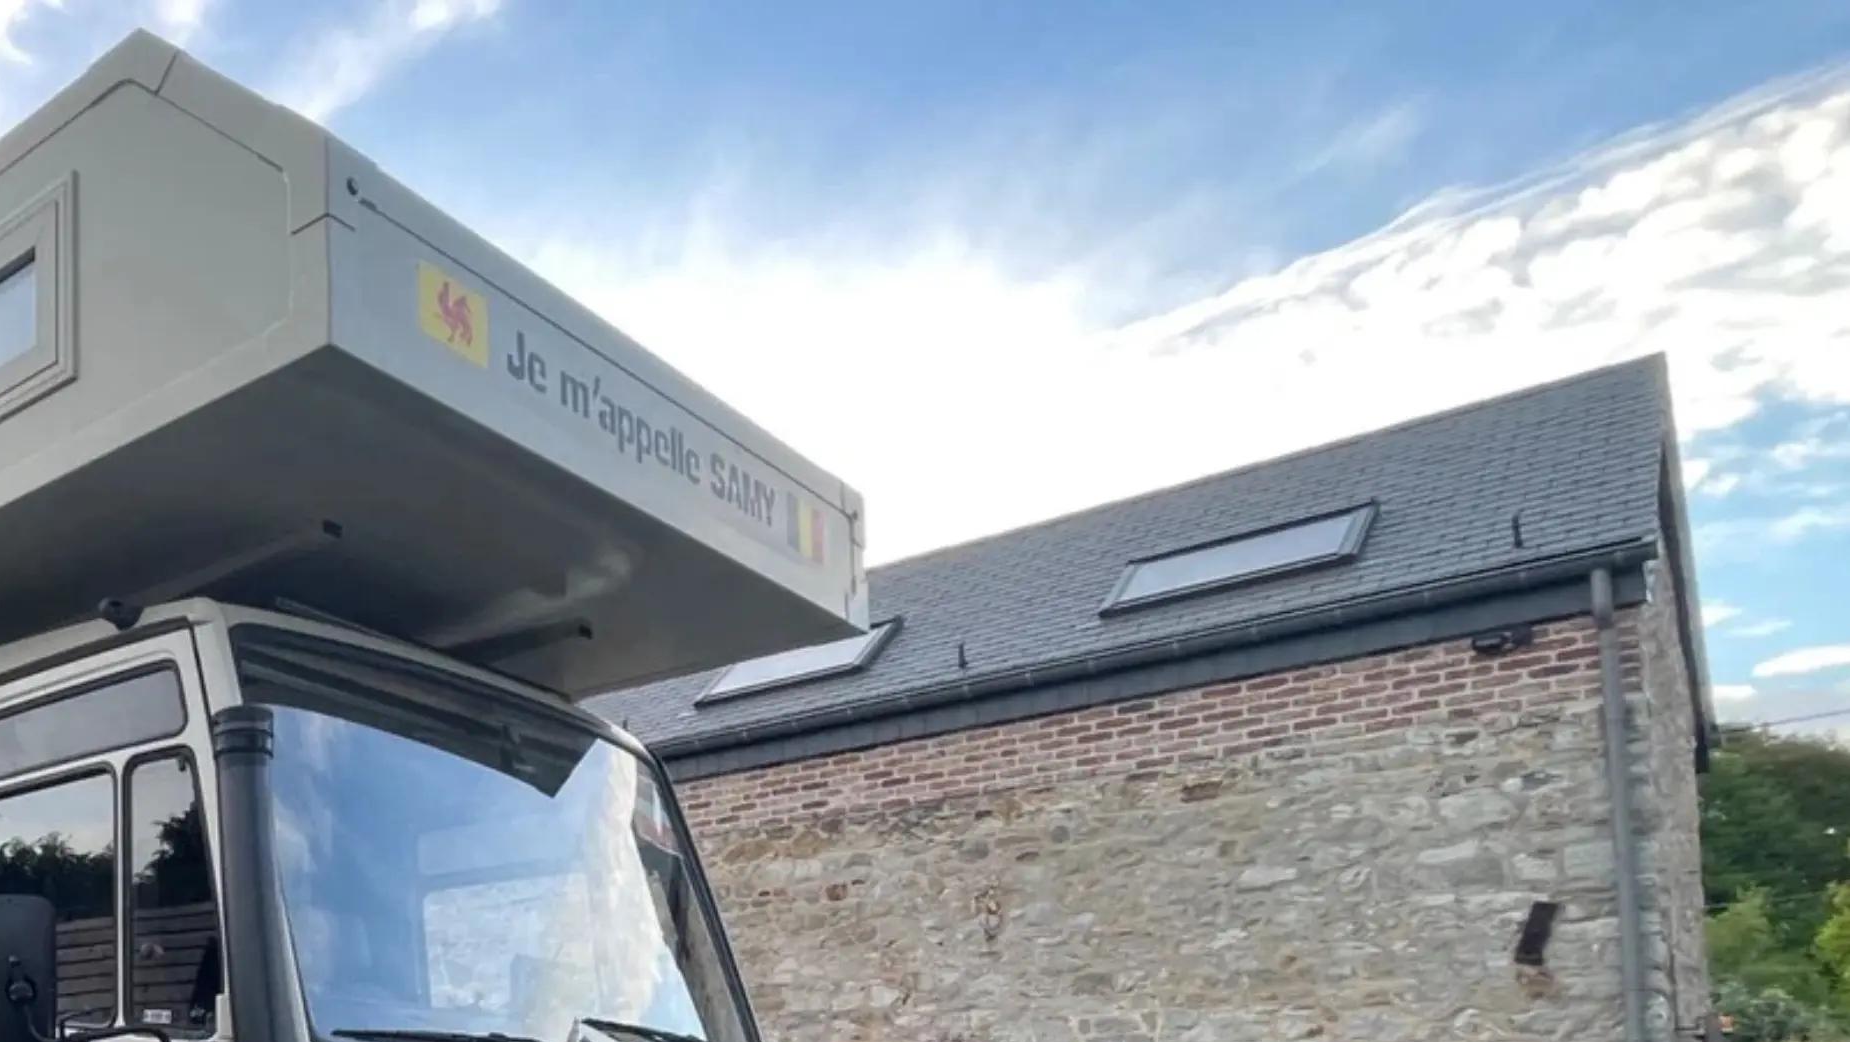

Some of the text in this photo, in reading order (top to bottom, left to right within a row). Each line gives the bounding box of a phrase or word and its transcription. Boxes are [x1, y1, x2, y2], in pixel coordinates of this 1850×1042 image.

[507, 329, 776, 527] Je m'appelle SAMY
